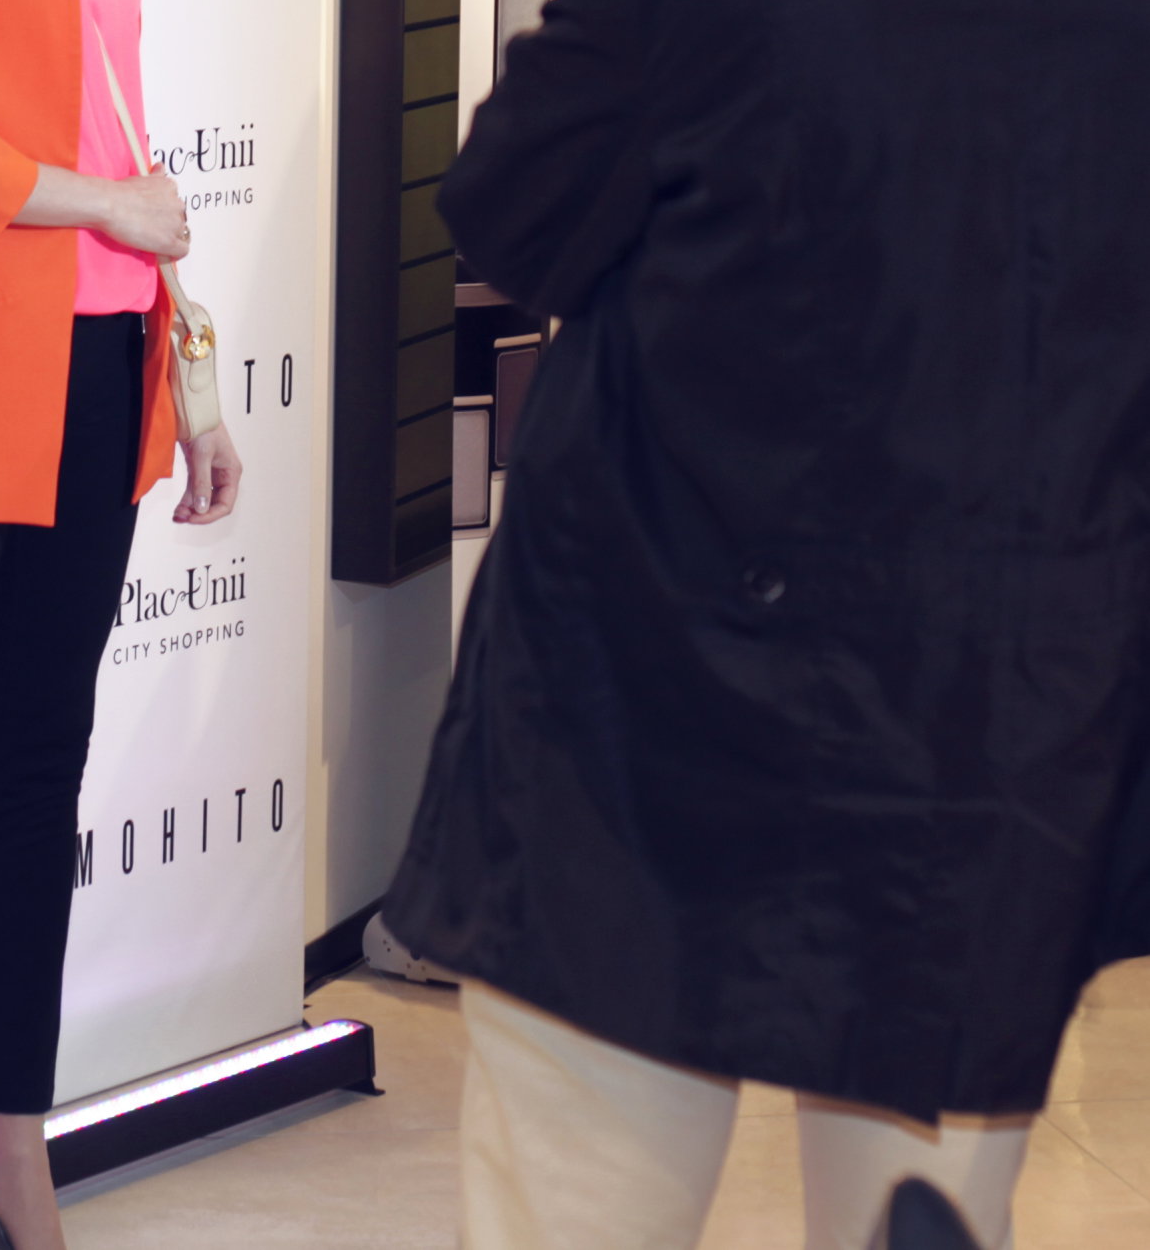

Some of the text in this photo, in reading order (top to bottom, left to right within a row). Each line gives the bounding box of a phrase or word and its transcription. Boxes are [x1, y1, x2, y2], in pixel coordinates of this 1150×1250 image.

[184, 187, 254, 212] OPPING
[113, 620, 244, 665] CITY SHOPPING
[74, 779, 283, 889] MOHITO
